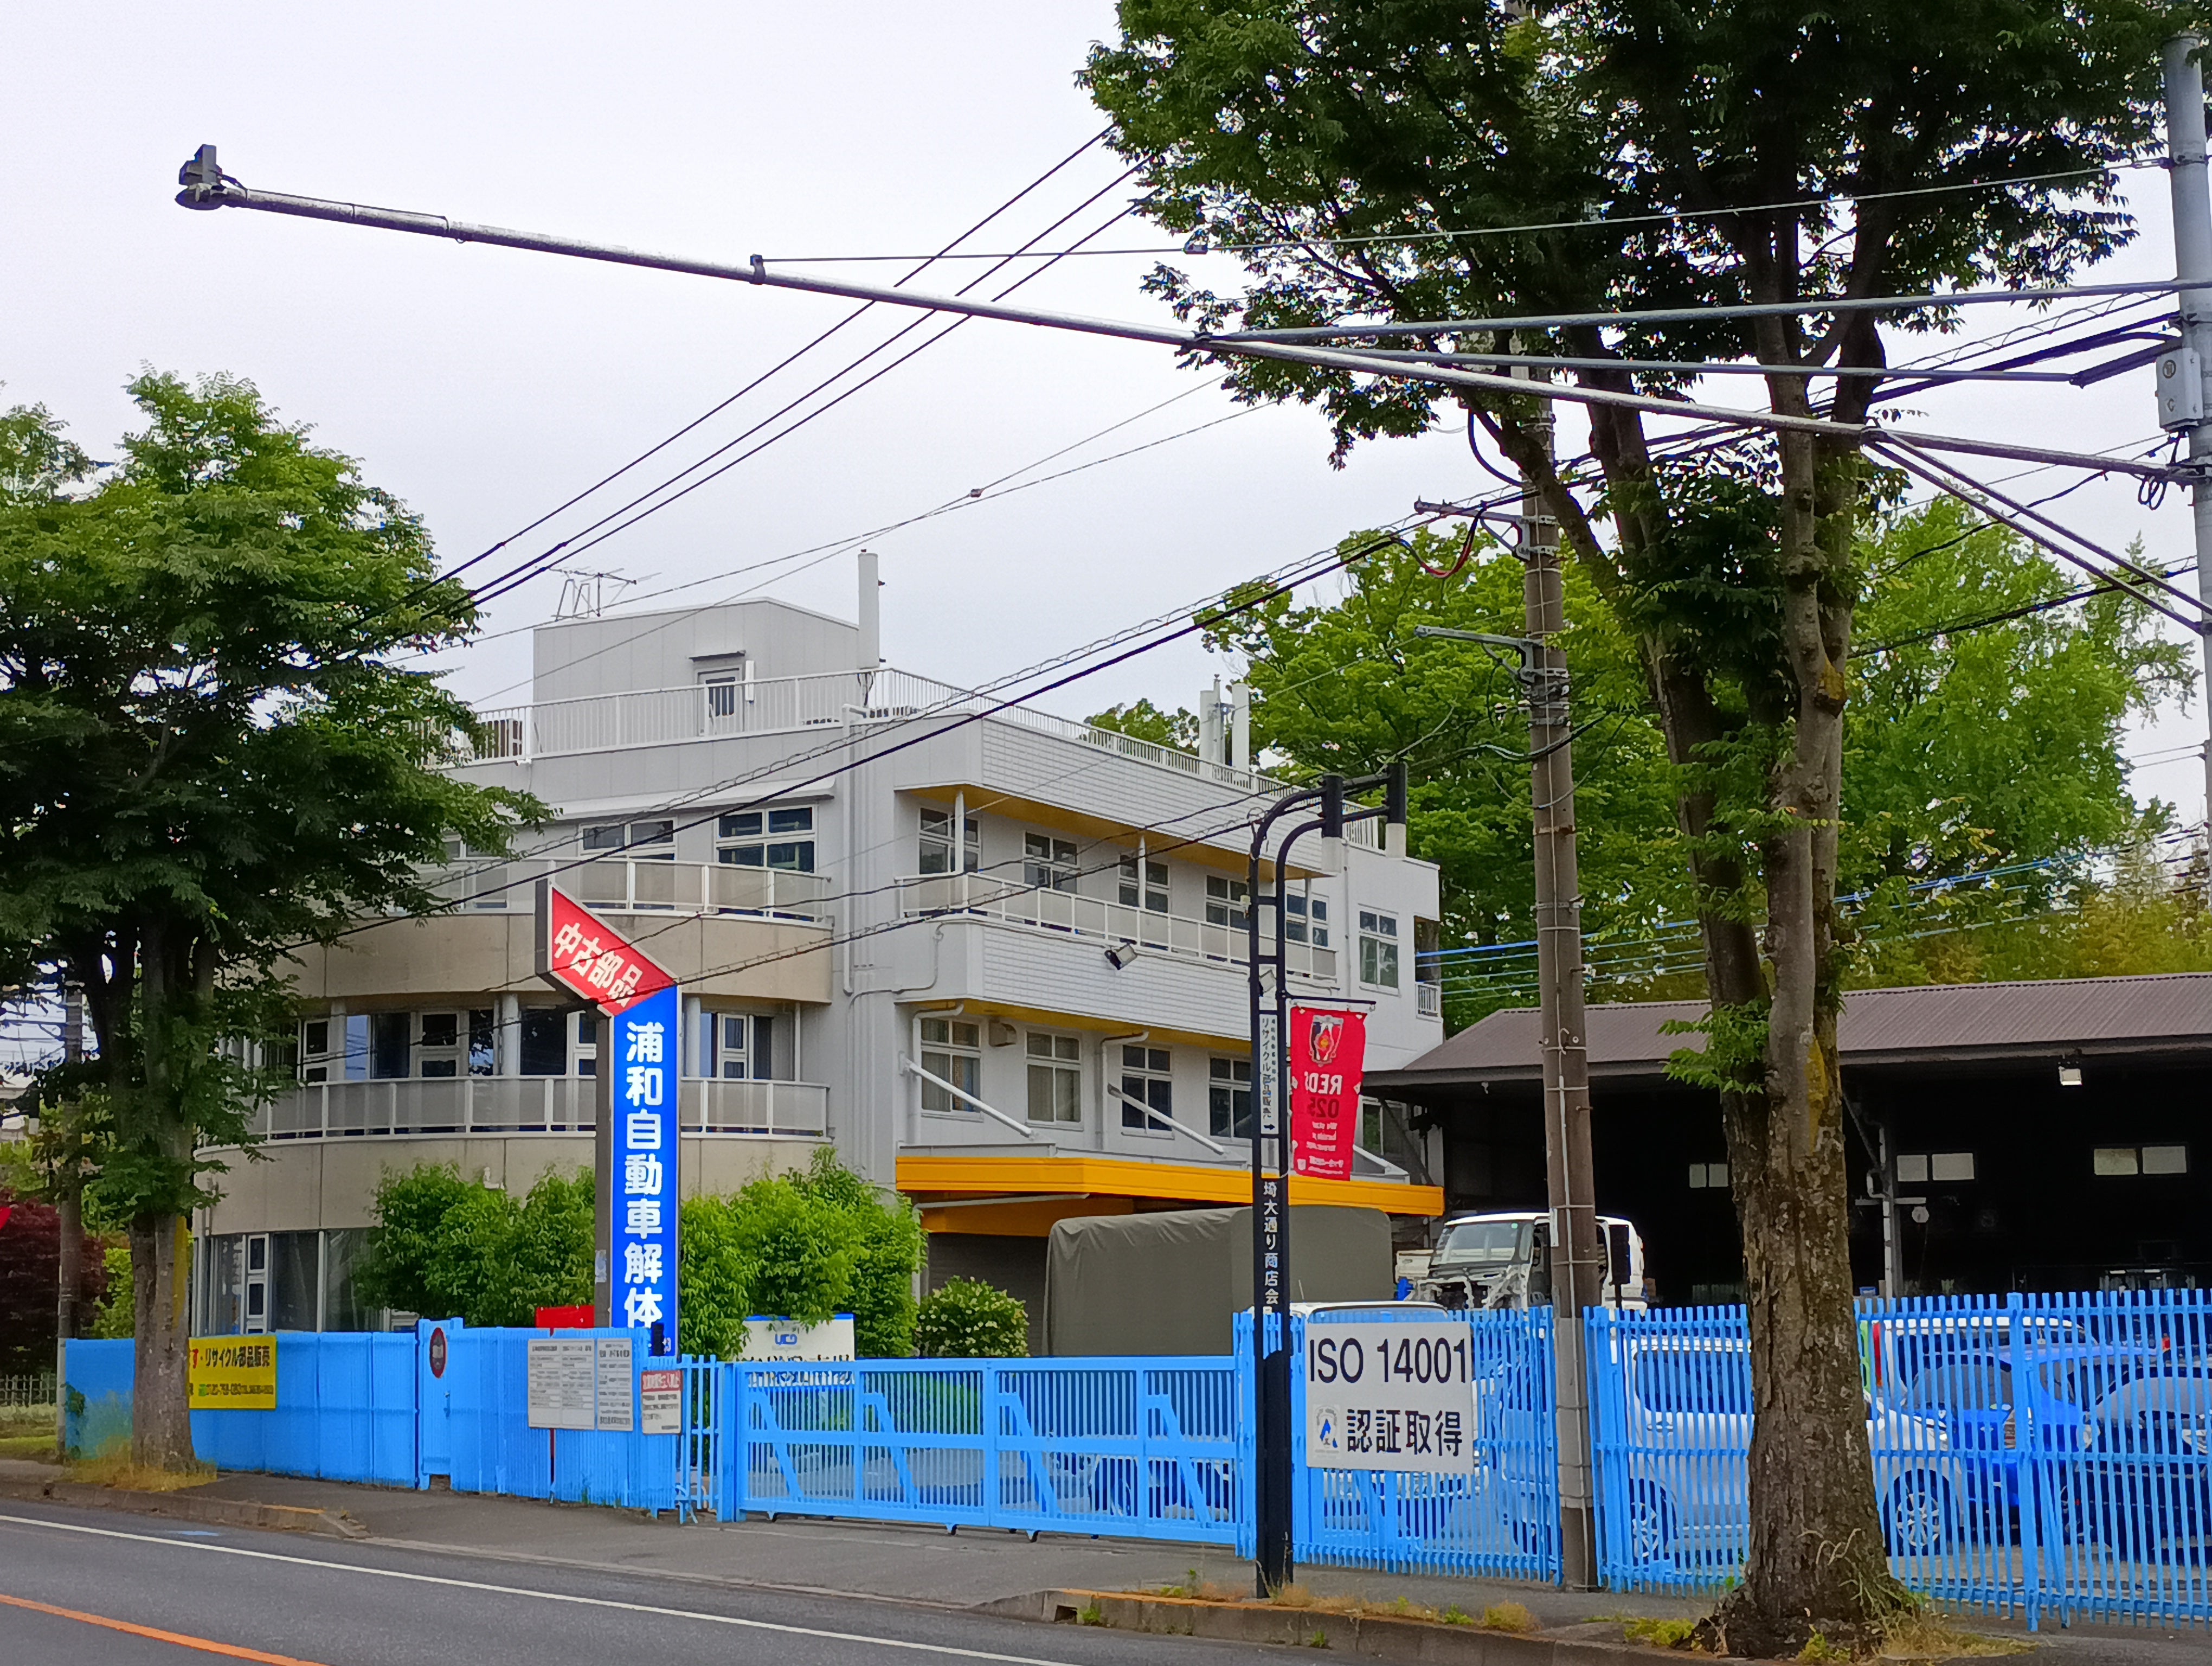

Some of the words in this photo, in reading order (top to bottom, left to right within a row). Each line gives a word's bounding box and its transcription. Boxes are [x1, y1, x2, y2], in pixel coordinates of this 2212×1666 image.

[554, 922, 642, 1008] 中古部品
[624, 1021, 664, 1328] 浦和自動車解体
[1263, 1181, 1278, 1304] 埼大通り商店会
[190, 1345, 269, 1369] す・リサイクル部品販売
[1310, 1338, 1364, 1383] ISO
[1377, 1338, 1465, 1383] 14001
[1346, 1409, 1463, 1457] 認証取得
